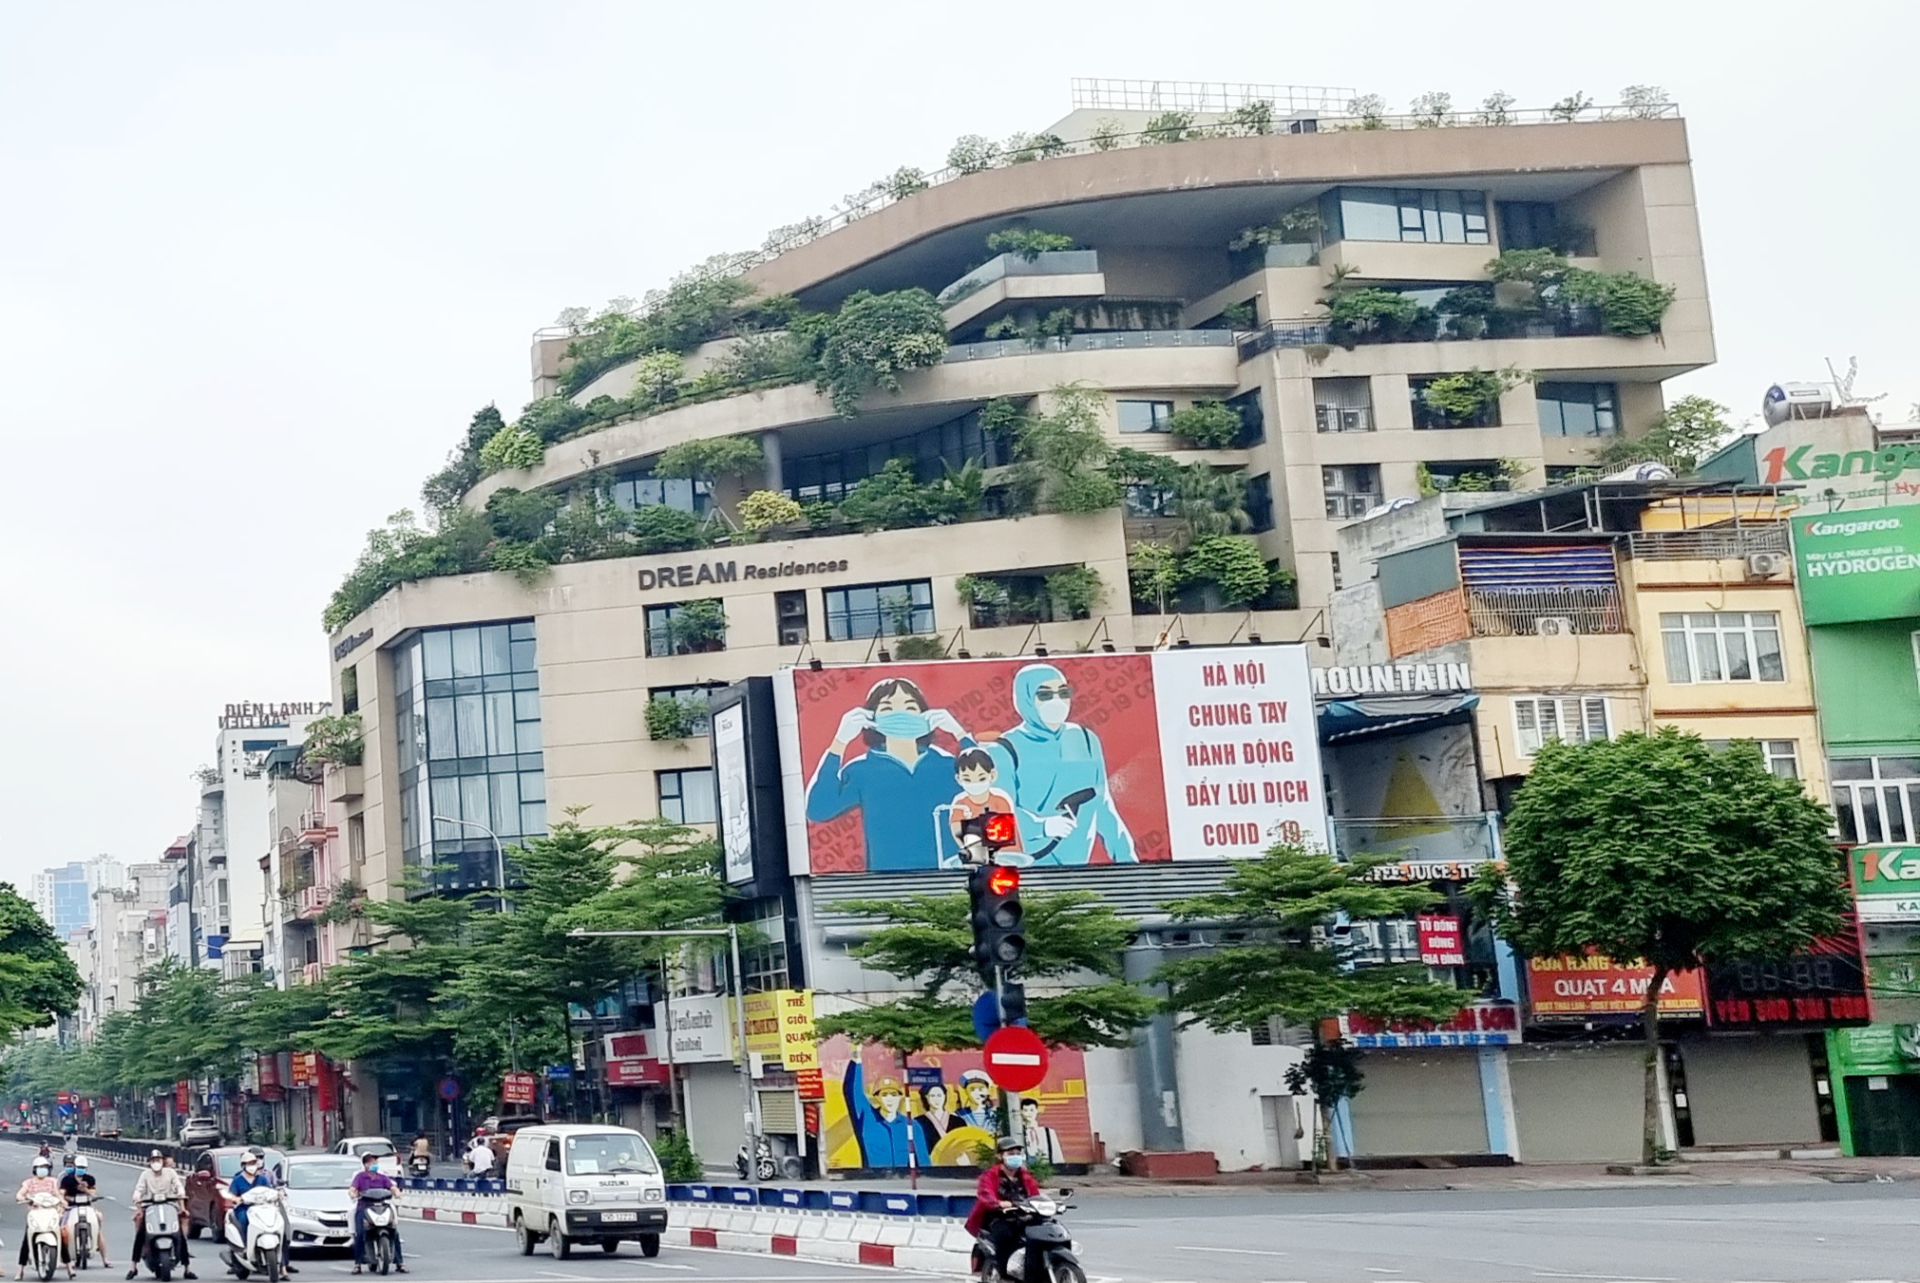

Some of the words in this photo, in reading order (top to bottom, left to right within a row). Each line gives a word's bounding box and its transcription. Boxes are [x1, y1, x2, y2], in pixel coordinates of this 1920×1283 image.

[1805, 518, 1902, 536] Kangaroo
[638, 561, 737, 591] DREAM
[744, 559, 848, 580] Residences
[1807, 554, 1920, 577] HYDROGEN
[1203, 661, 1228, 686] HÀ
[1234, 660, 1265, 689] NỘI
[270, 702, 314, 719] LẠNH
[1188, 703, 1252, 727] CHUNG
[1257, 701, 1288, 724] TAY
[1186, 741, 1236, 766] HÀNH
[1242, 738, 1294, 768] ĐỘNG
[1186, 777, 1220, 806] ĐẨY
[1228, 779, 1257, 805] LÙI
[1263, 780, 1309, 807] DỊCH
[1203, 822, 1259, 846] COVID
[1408, 864, 1451, 880] JUICE
[1458, 863, 1481, 878] TE
[1555, 979, 1606, 1000] QUẠT
[1611, 979, 1625, 994] 4
[786, 996, 805, 1006] THẾ
[787, 1013, 807, 1024] GIỚI
[789, 1052, 812, 1064] ĐIỆN
